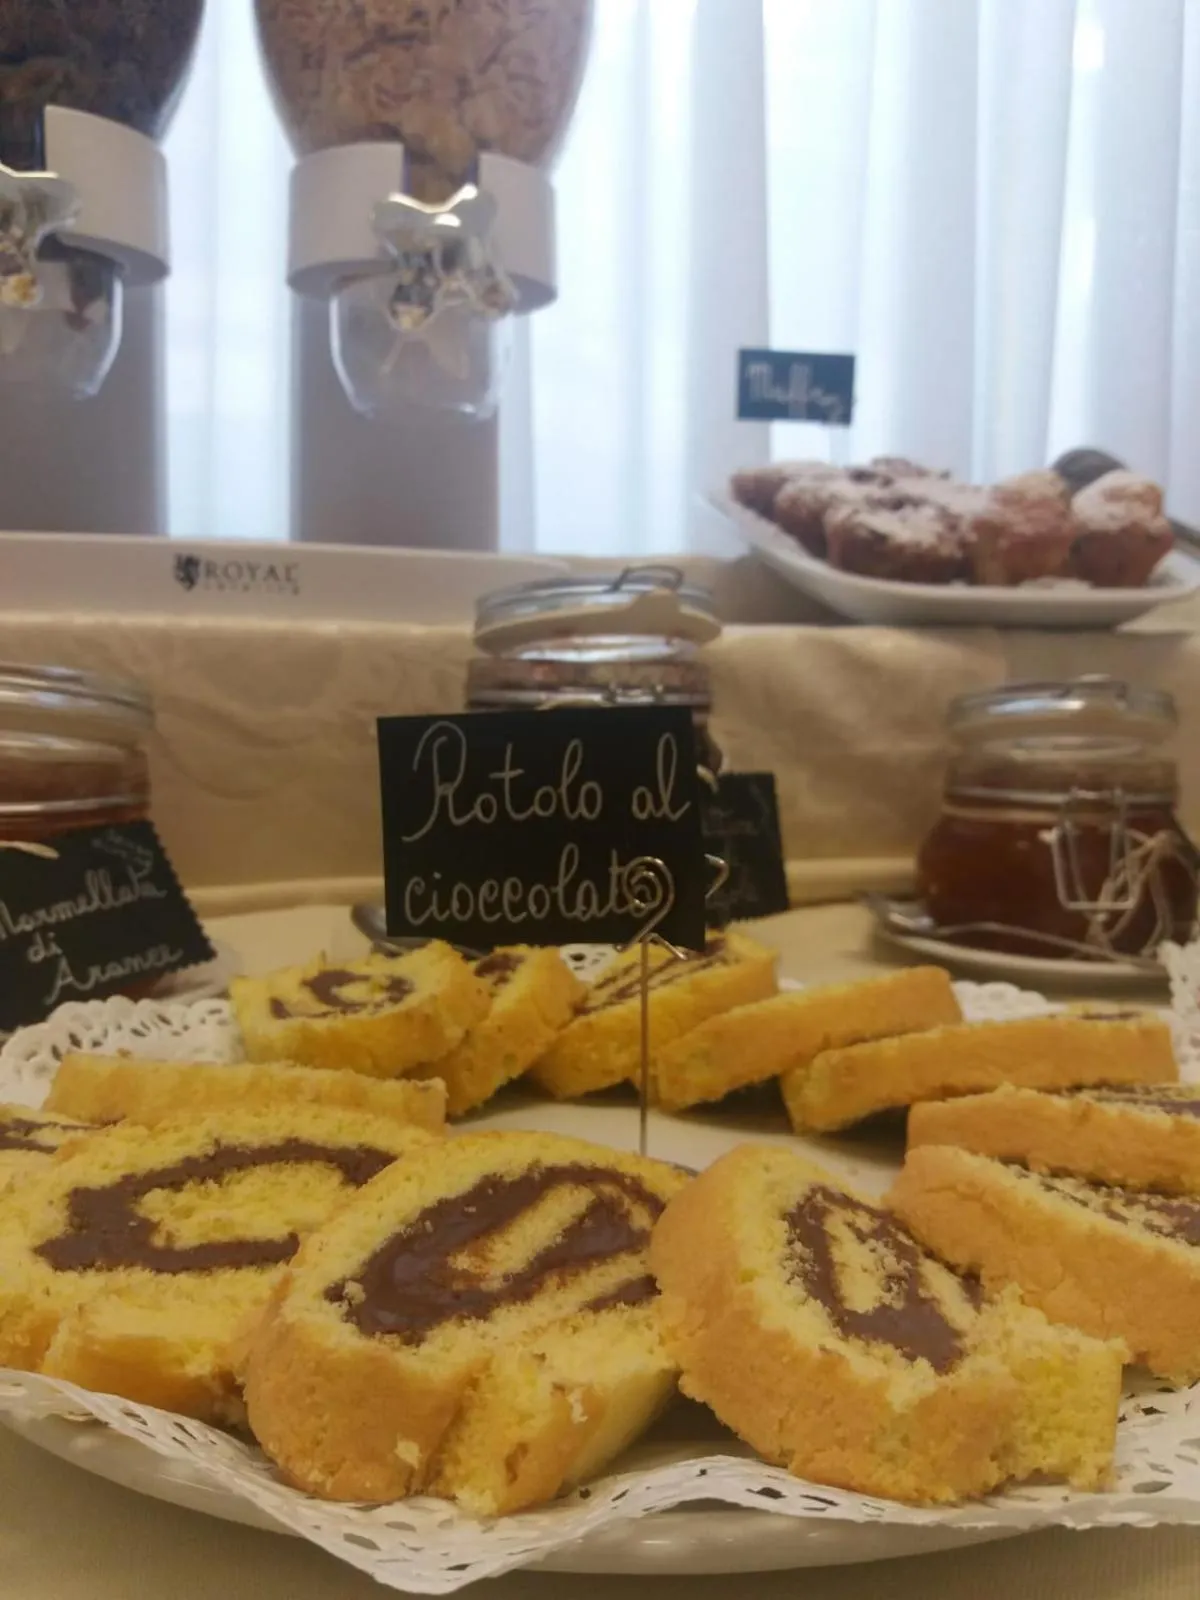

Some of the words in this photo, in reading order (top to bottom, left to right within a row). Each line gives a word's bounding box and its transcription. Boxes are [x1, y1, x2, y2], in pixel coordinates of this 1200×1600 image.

[401, 721, 602, 842] Rotolo
[632, 732, 691, 820] al
[404, 843, 655, 926] cioccolato
[27, 932, 62, 963] di
